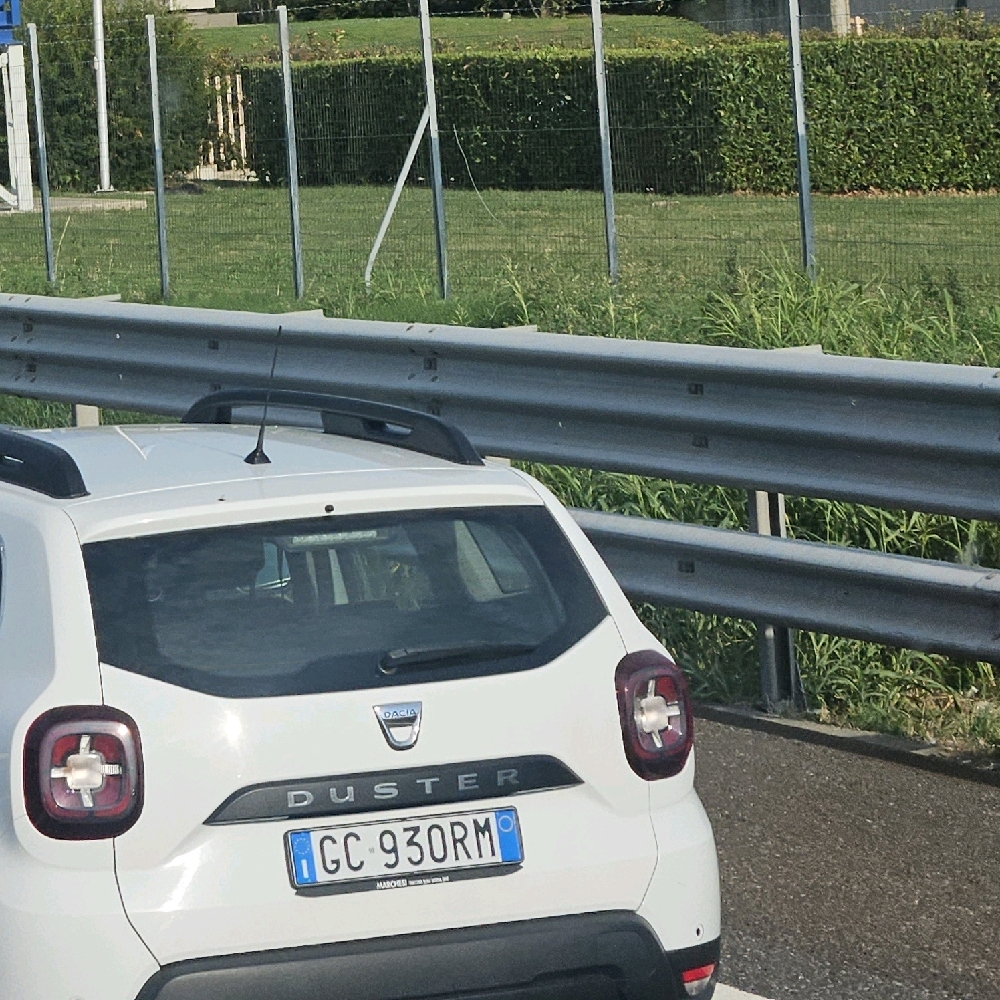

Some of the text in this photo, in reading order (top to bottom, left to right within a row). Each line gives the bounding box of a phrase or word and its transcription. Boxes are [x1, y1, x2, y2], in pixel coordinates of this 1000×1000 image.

[384, 709, 417, 719] DACIA
[287, 768, 520, 808] DUSTER
[319, 832, 365, 875] GC
[378, 817, 497, 869] 930RM
